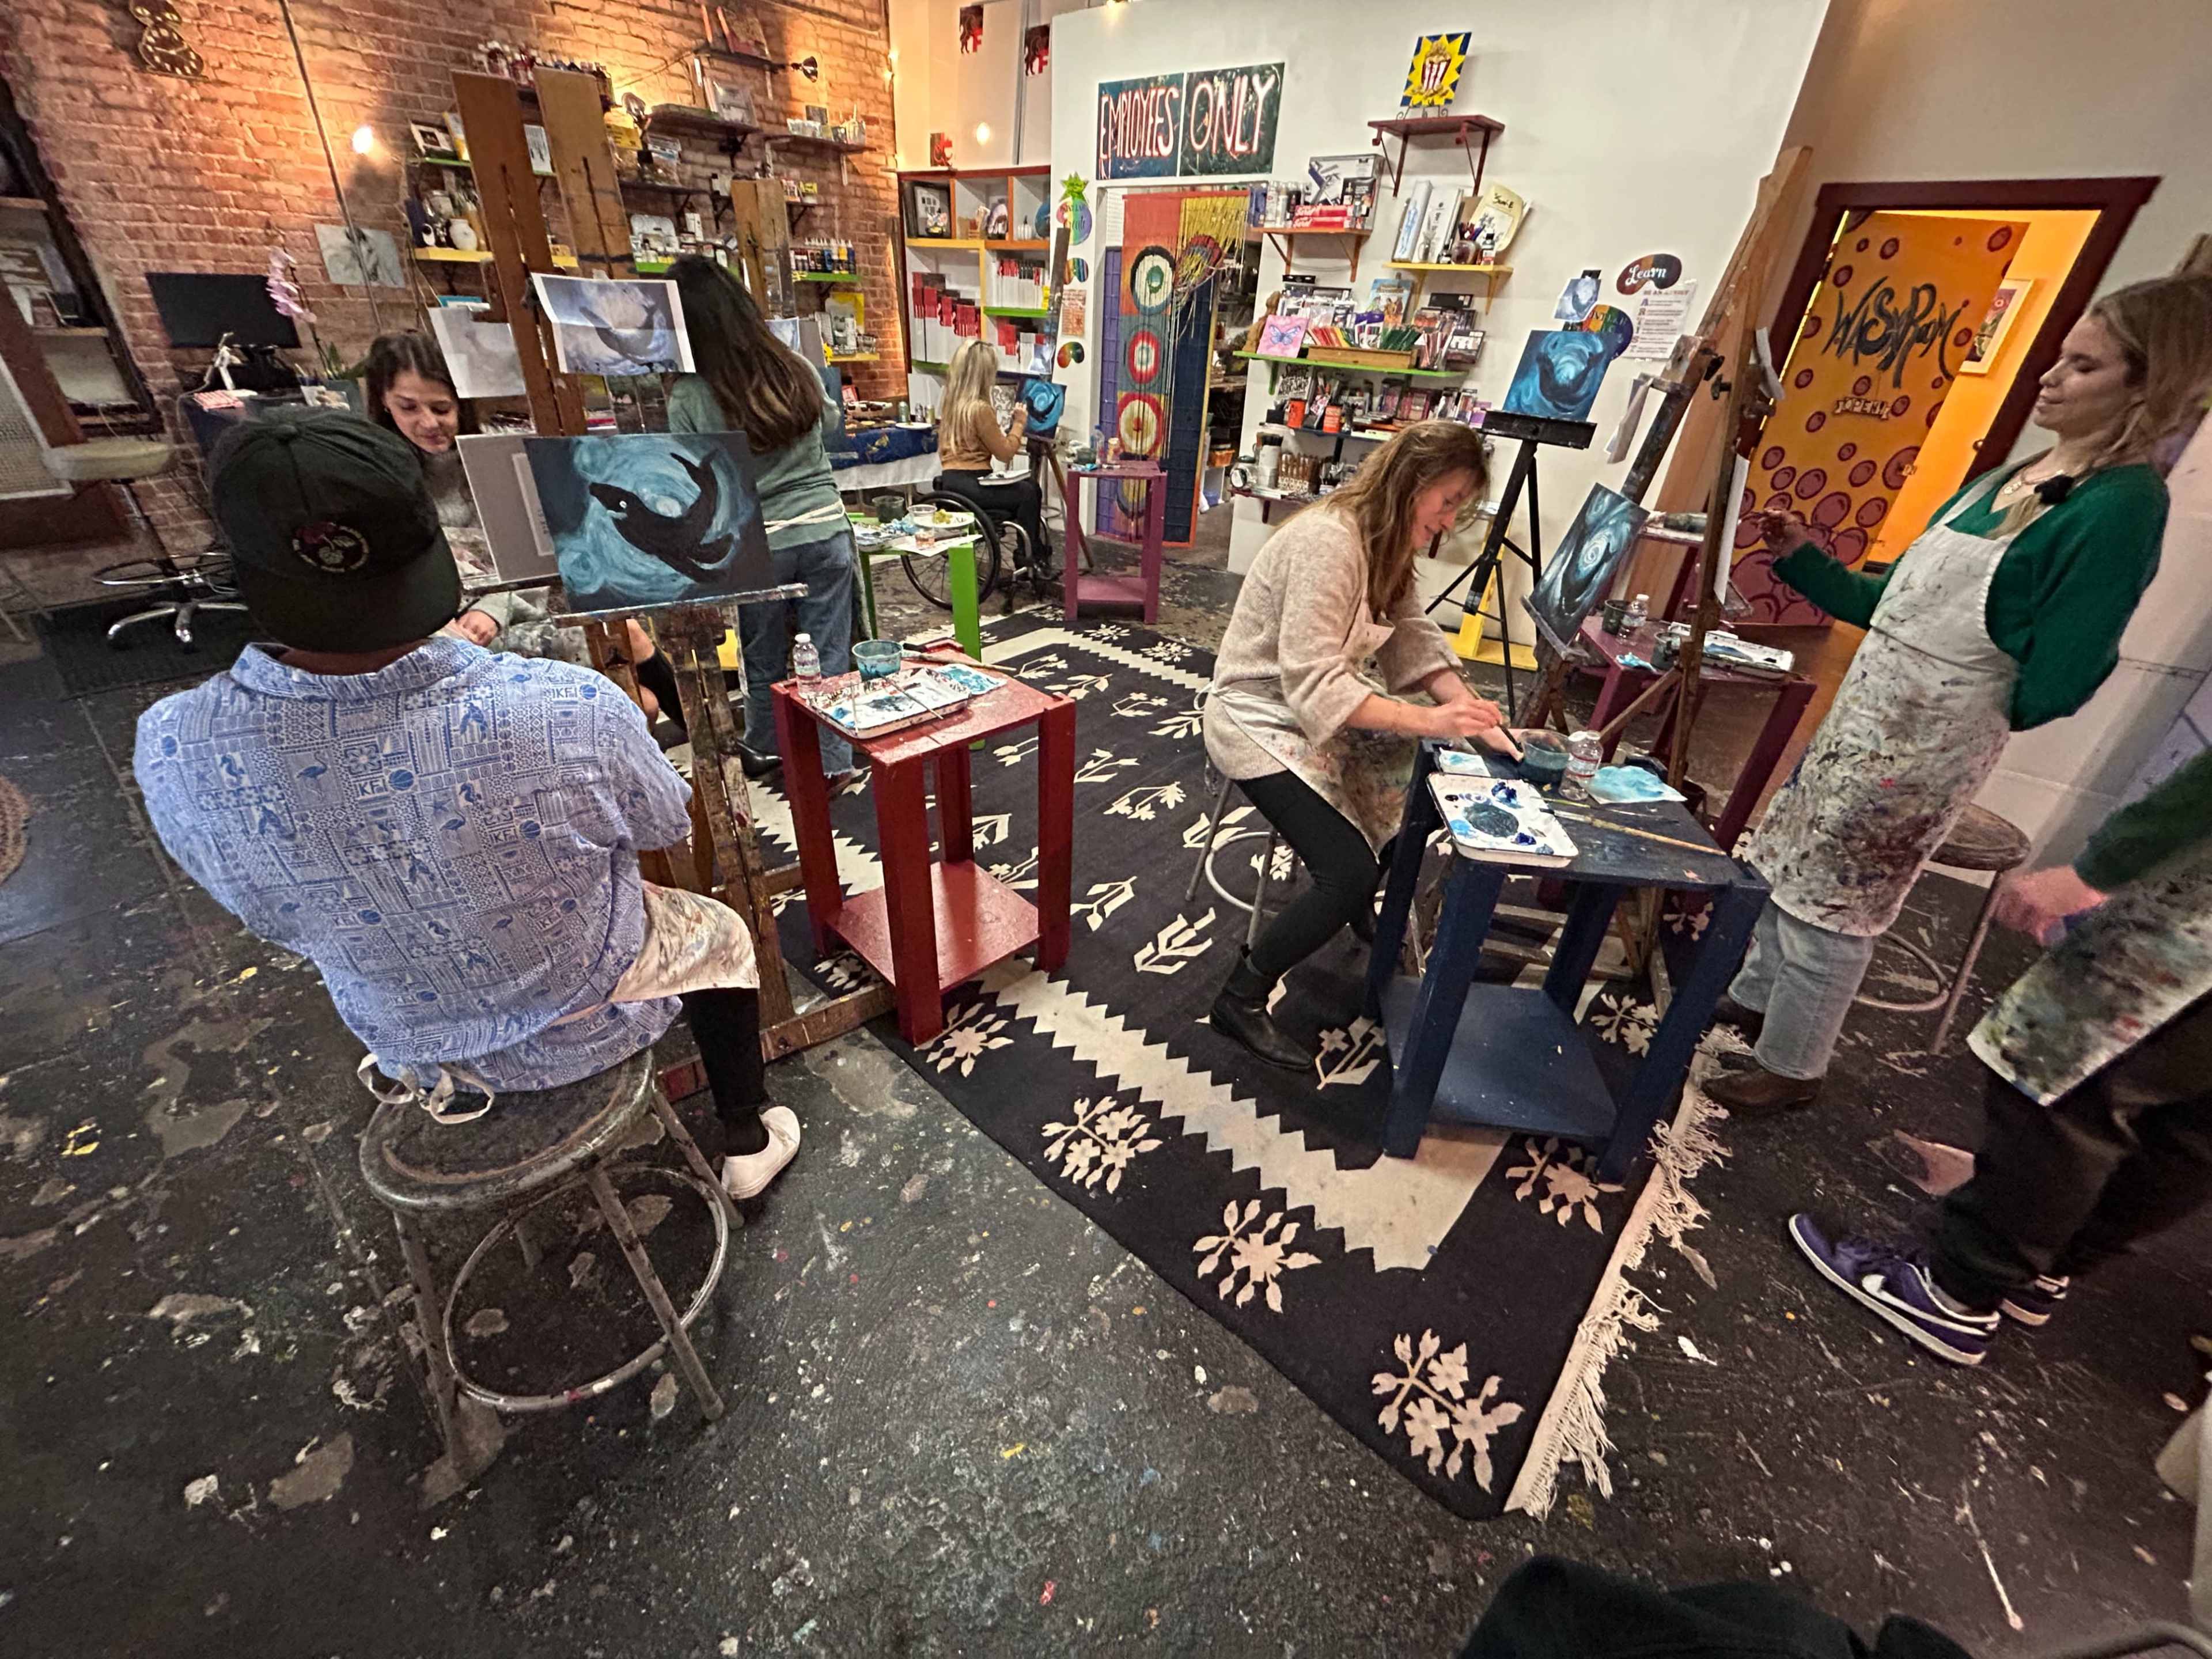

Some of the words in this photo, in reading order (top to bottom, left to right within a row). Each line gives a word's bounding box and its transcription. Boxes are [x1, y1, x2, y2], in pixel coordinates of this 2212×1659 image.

[1099, 86, 1179, 160] EMPLOYEES
[1190, 73, 1276, 154] ONLY
[1625, 264, 1666, 286] Learn
